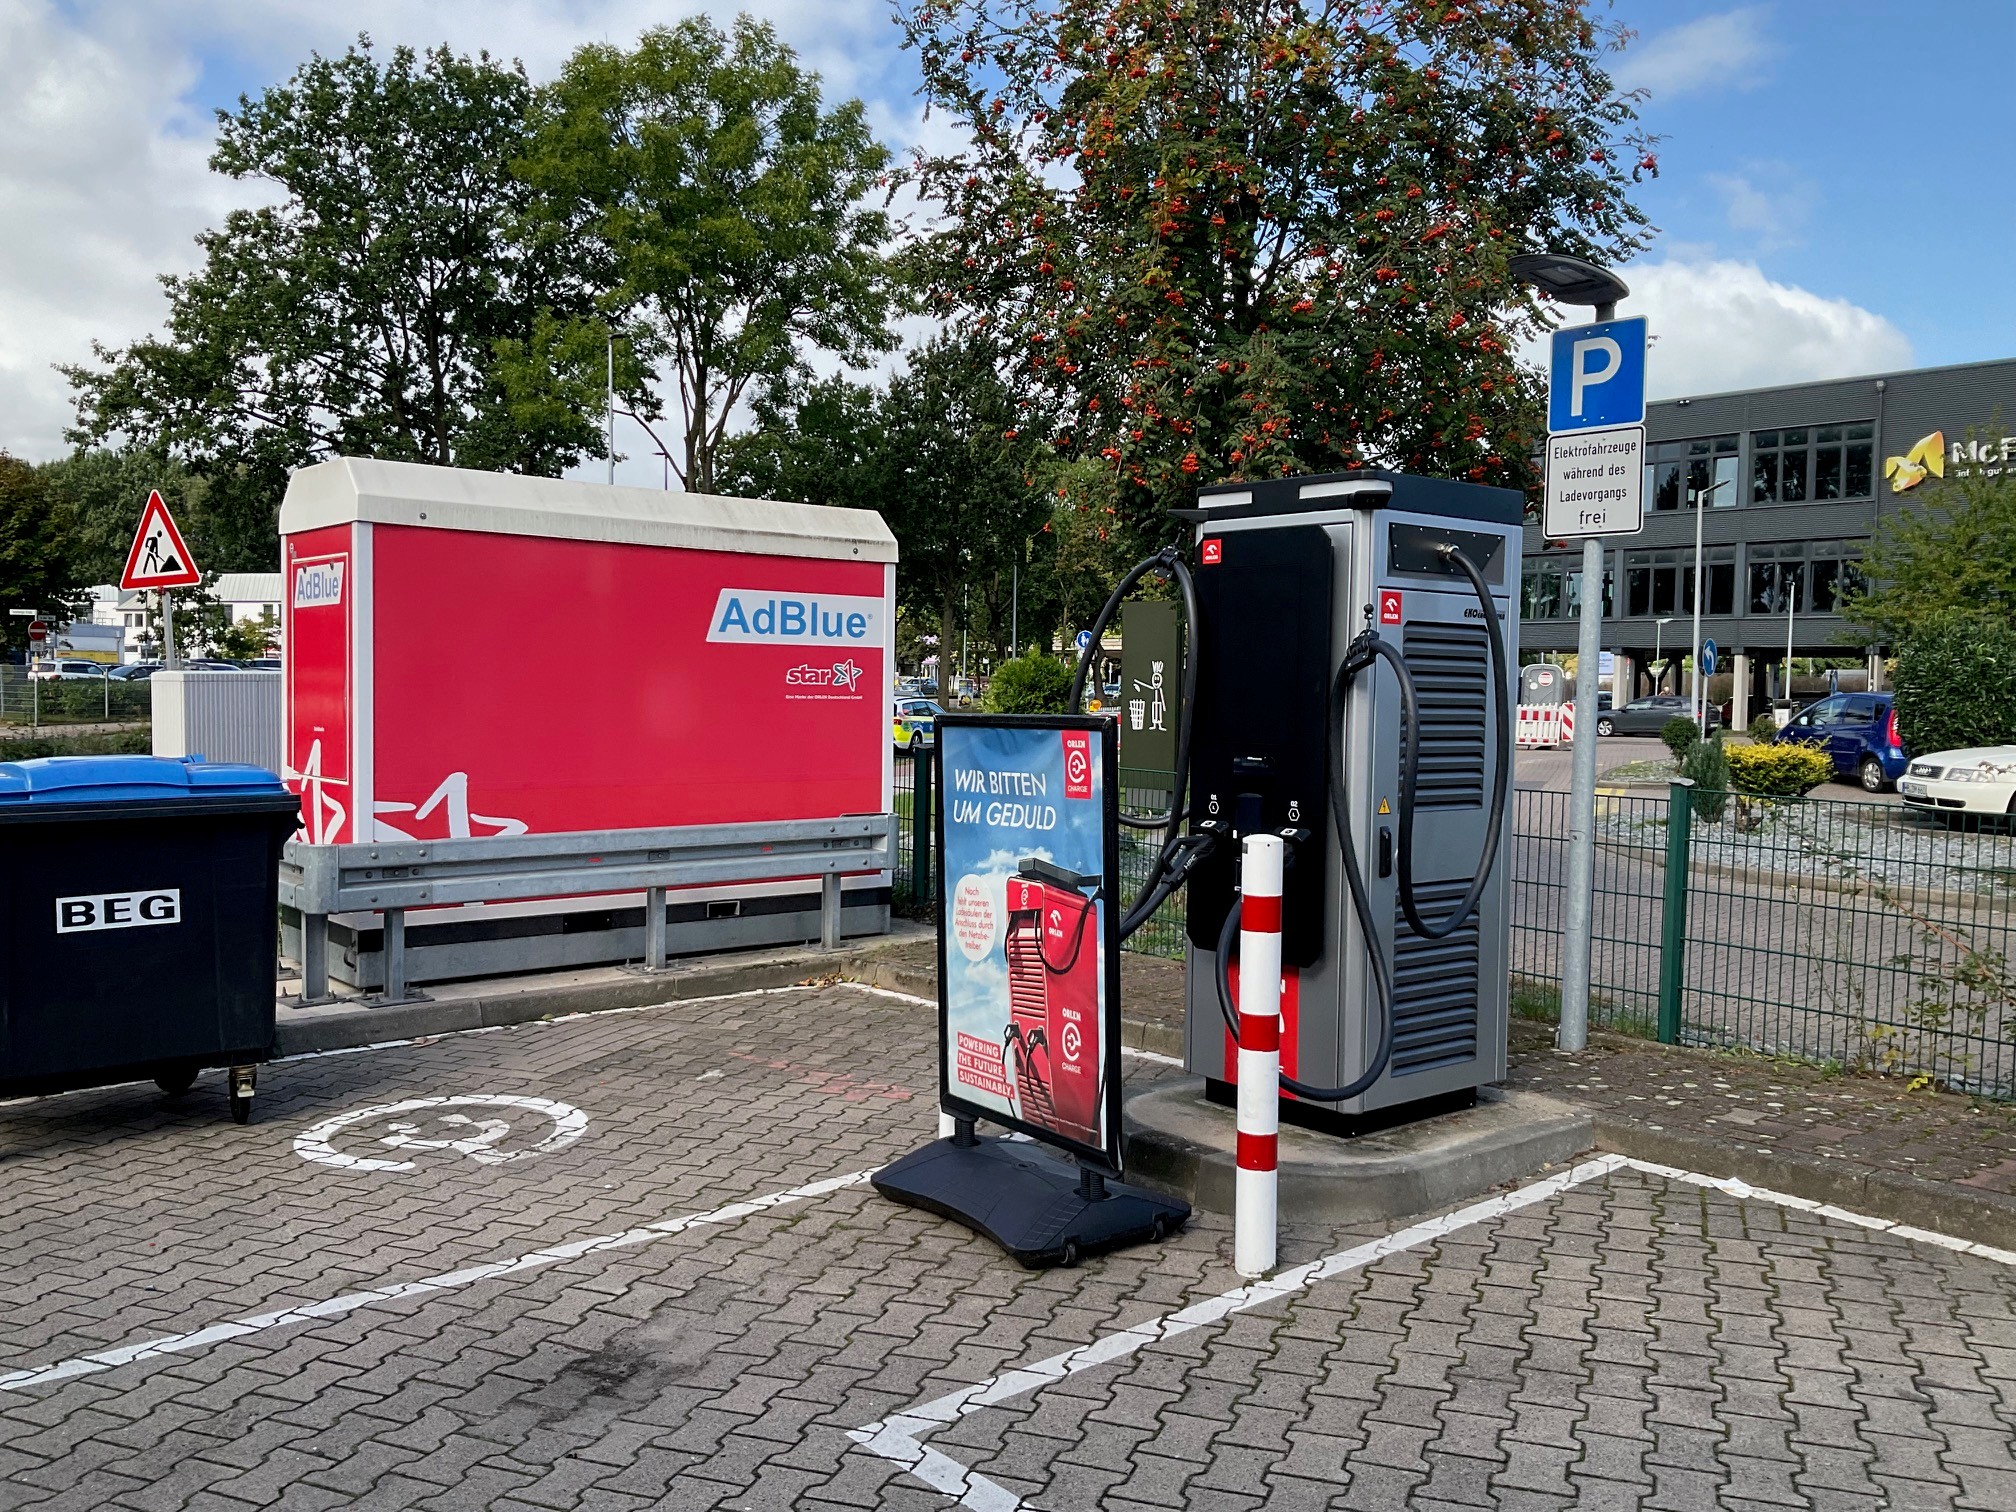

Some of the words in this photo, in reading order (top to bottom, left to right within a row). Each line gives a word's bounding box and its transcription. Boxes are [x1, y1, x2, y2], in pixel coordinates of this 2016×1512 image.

[1571, 336, 1622, 417] P
[1554, 441, 1637, 459] Elektrofahrzeuge
[1563, 464, 1604, 480] während
[1608, 463, 1626, 476] des
[1560, 488, 1627, 502] Ladevorgangs
[1579, 508, 1606, 524] frei
[1383, 612, 1399, 620] ORLEN
[786, 664, 832, 685] star
[1067, 739, 1086, 748] ORLEN
[955, 769, 987, 794] WIR
[989, 771, 1047, 797] BITTEN
[1067, 785, 1088, 793] CHARGE
[953, 800, 982, 824] UM
[986, 801, 1057, 831] GEDULD
[964, 886, 980, 896] Noch
[61, 895, 175, 928] BEG
[968, 900, 990, 908] unseren
[983, 910, 993, 919] der
[959, 928, 968, 937] den
[978, 920, 994, 930] durch
[1048, 927, 1063, 938] ORLEN
[1062, 1007, 1081, 1022] ORLEN
[959, 1034, 999, 1058] POWERING
[959, 1052, 972, 1067] THE
[973, 1057, 1006, 1078] FUTURE.
[1061, 1061, 1082, 1075] CHARGE
[959, 1070, 1014, 1098] SUSTAINABLY.
